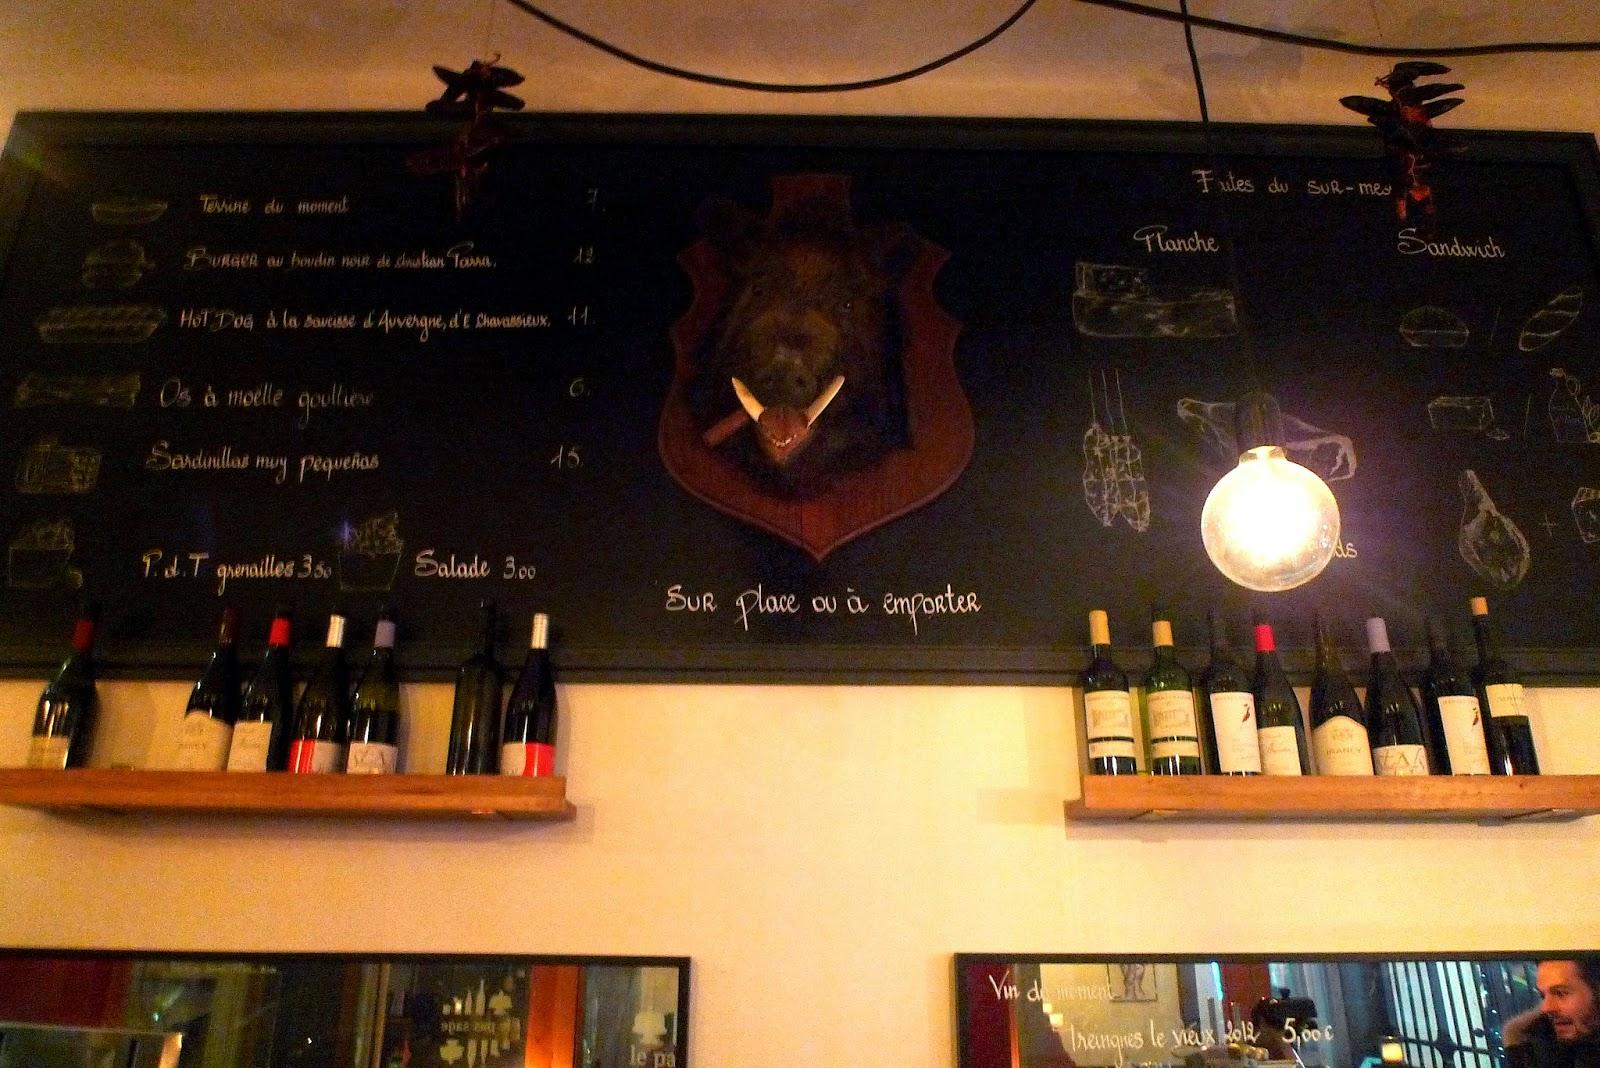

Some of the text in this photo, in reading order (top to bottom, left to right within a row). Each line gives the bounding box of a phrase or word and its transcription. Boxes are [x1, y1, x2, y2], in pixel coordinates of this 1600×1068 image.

[1267, 176, 1290, 194] du
[199, 193, 350, 215] Terrine du moment
[1133, 224, 1220, 254] Planche
[1397, 227, 1507, 260] Sandwich
[291, 250, 337, 269] boudin
[376, 252, 392, 269] de
[283, 307, 299, 330] la
[204, 382, 220, 408] à
[255, 455, 288, 485] muy
[299, 452, 381, 484] pequeñas
[216, 553, 296, 597] grenailles
[414, 548, 491, 579] Salade
[735, 582, 801, 632] place
[811, 596, 838, 614] ou
[846, 586, 870, 614] à
[988, 970, 1020, 1001] Vin
[1149, 1018, 1167, 1049] le
